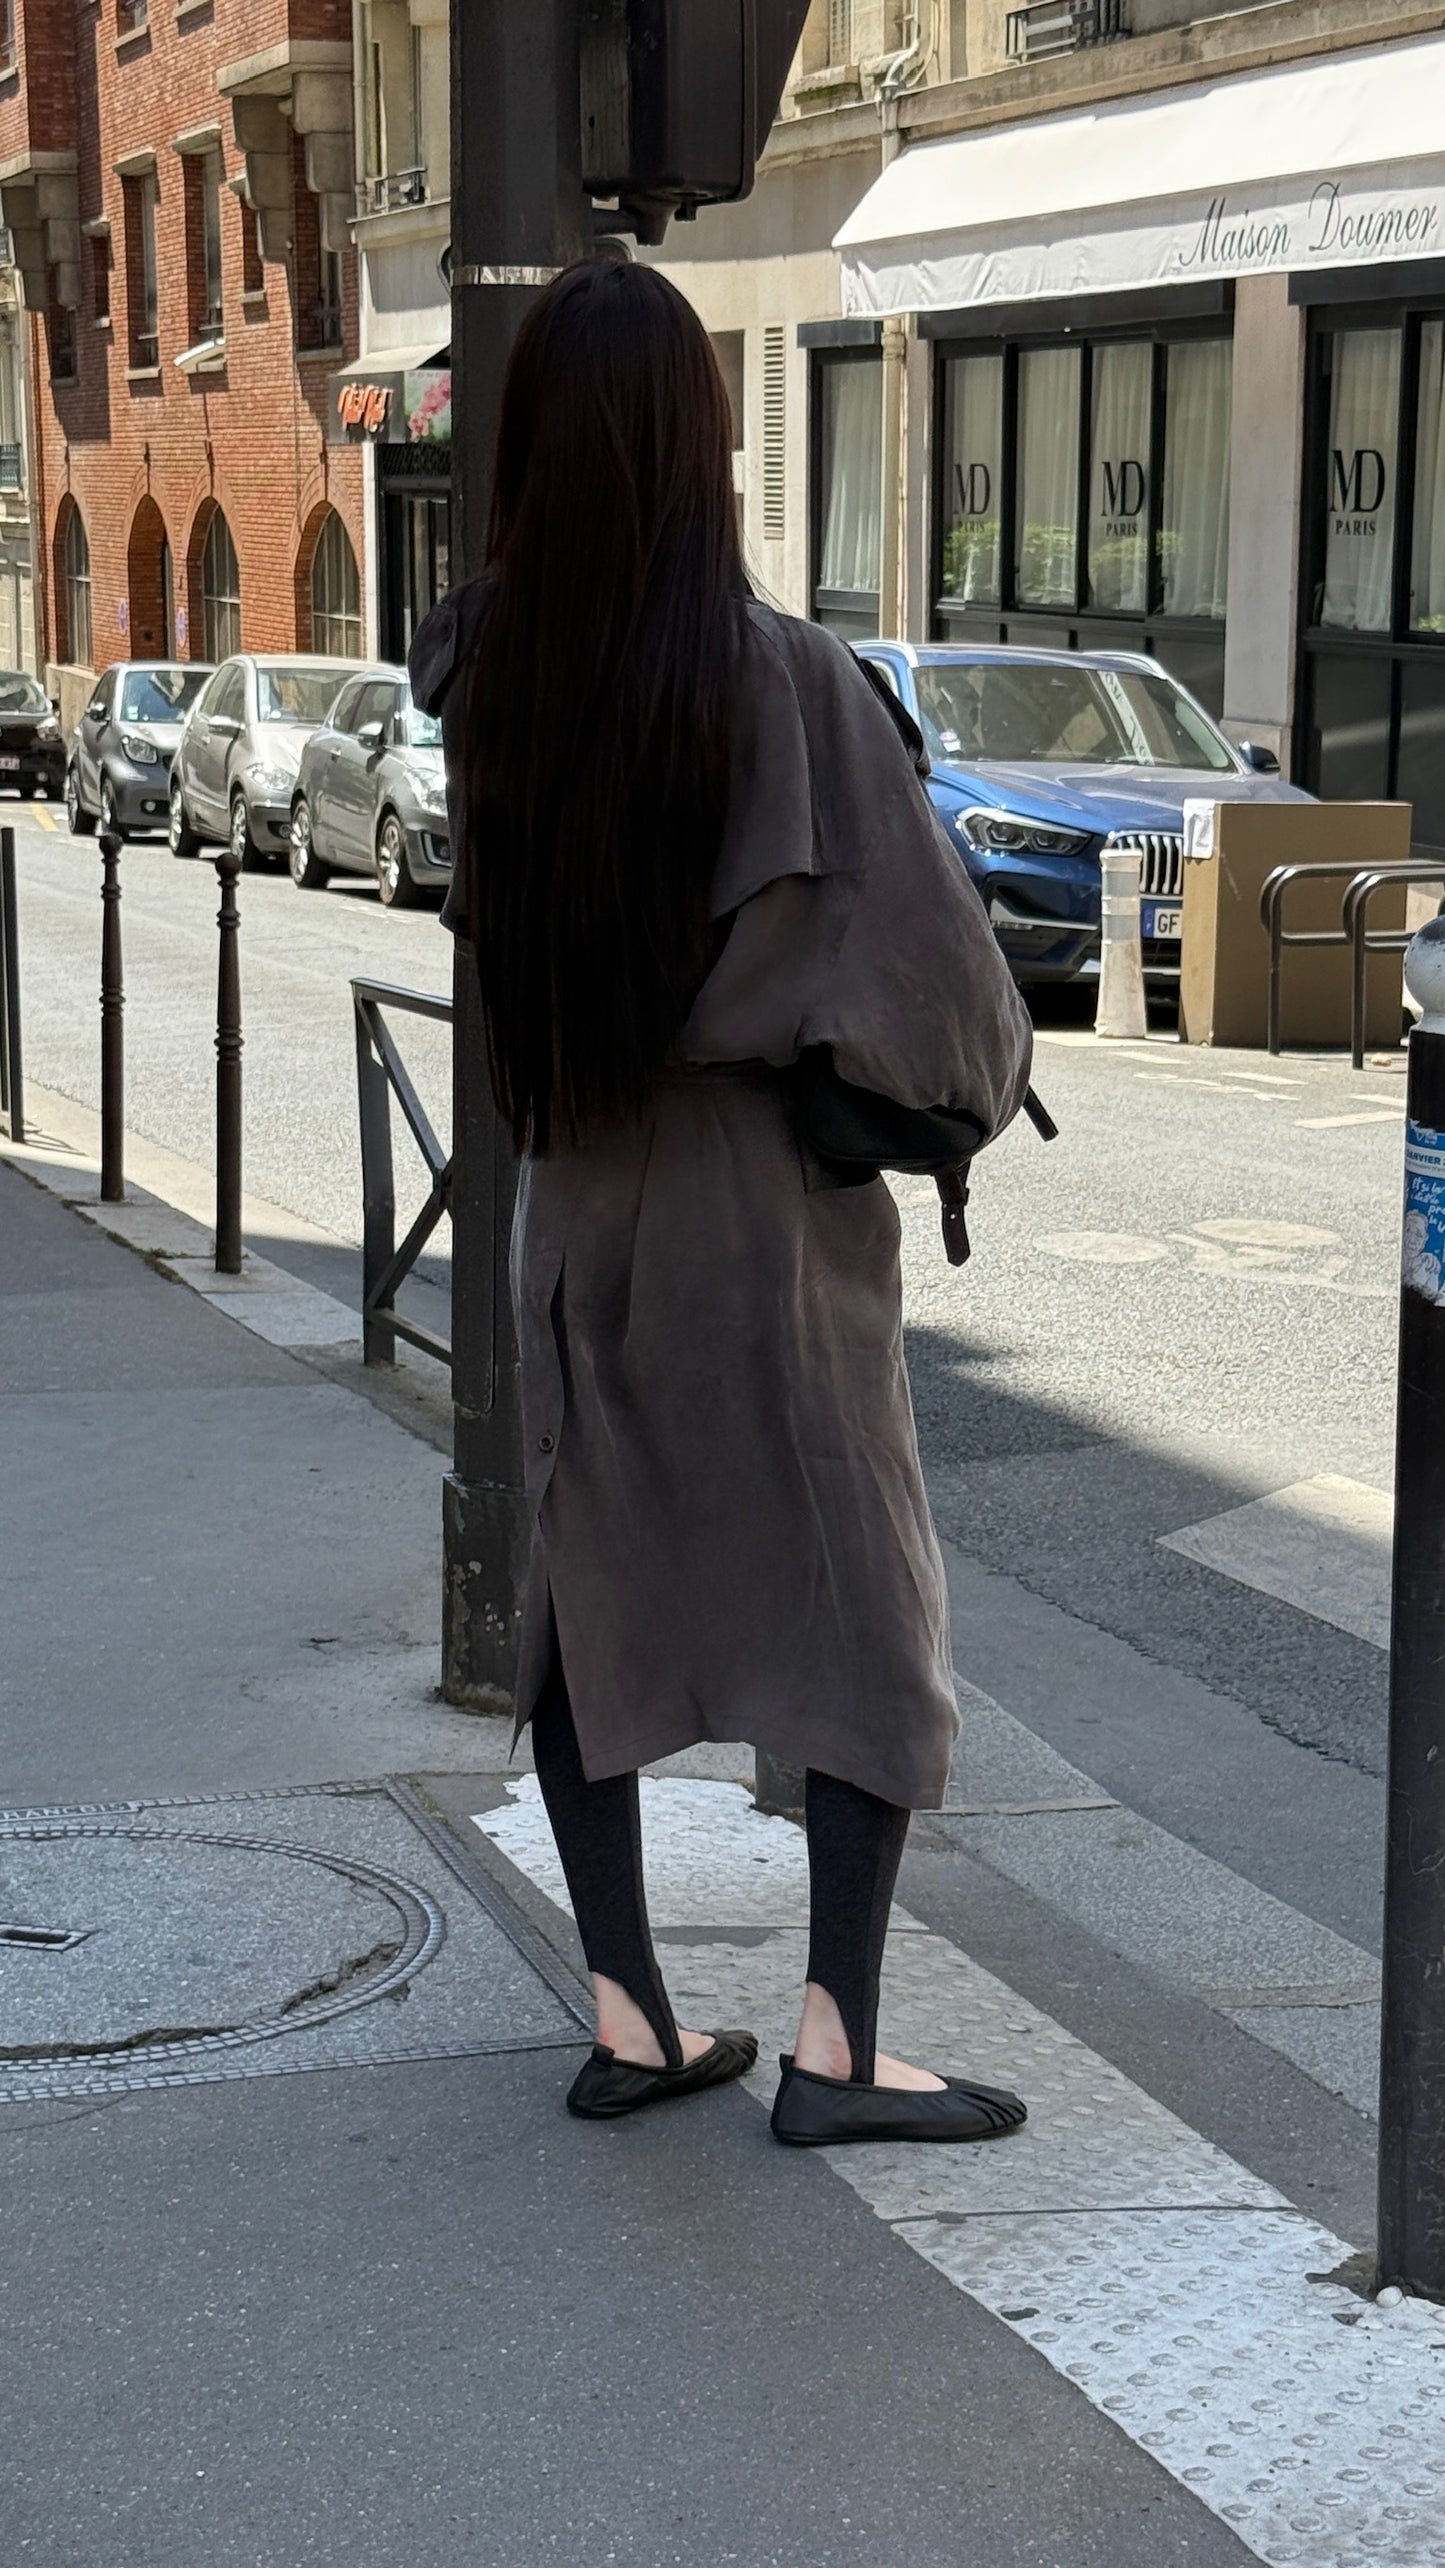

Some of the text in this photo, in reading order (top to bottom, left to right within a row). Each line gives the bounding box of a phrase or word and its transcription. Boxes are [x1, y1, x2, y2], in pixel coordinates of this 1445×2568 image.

[1179, 182, 1437, 266] Maison Doumer
[953, 463, 990, 515] MD
[1101, 460, 1145, 517] MD
[1330, 449, 1385, 513] MD
[1106, 521, 1138, 537] PARIS
[1335, 519, 1376, 536] PARIS
[1158, 913, 1180, 934] GF
